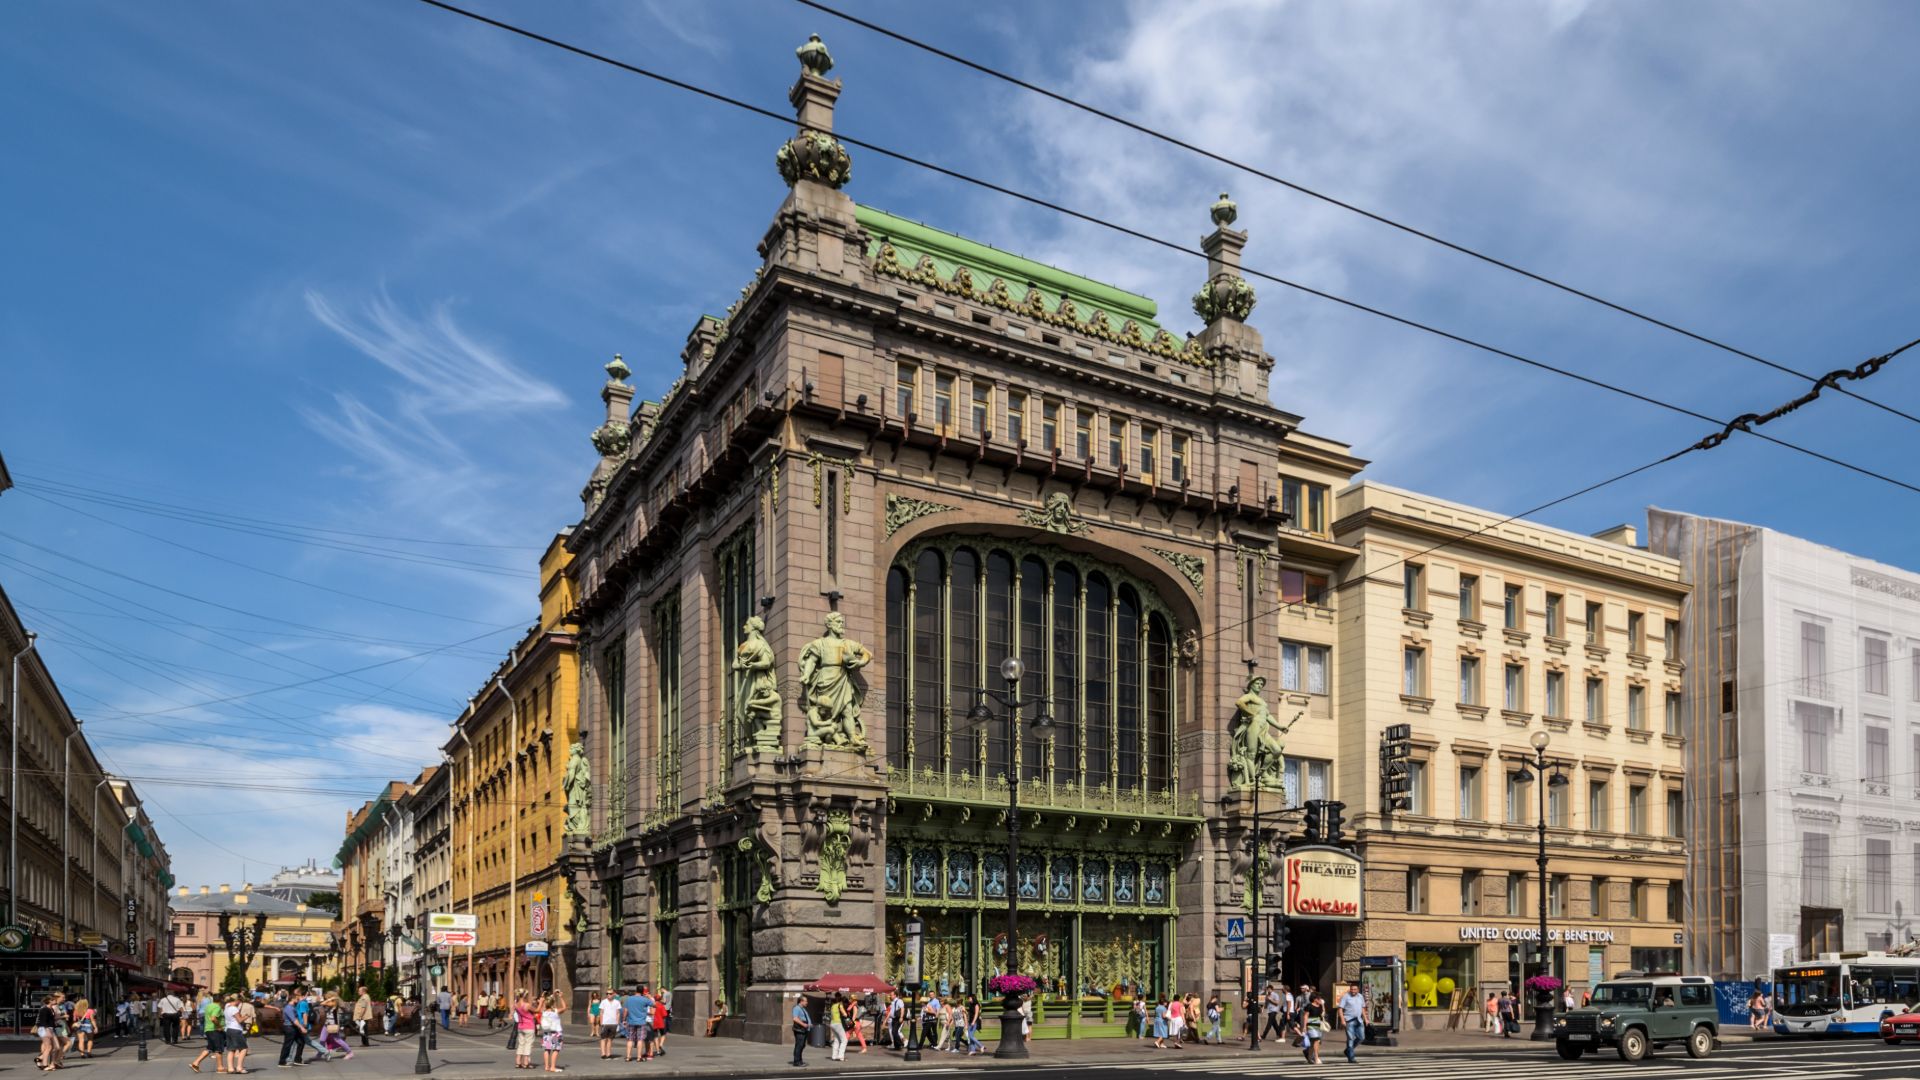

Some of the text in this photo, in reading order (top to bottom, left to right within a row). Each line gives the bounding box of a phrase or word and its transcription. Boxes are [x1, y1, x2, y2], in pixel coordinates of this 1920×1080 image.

[1461, 927, 1613, 942] UNITED COLORS OF BENETTON
